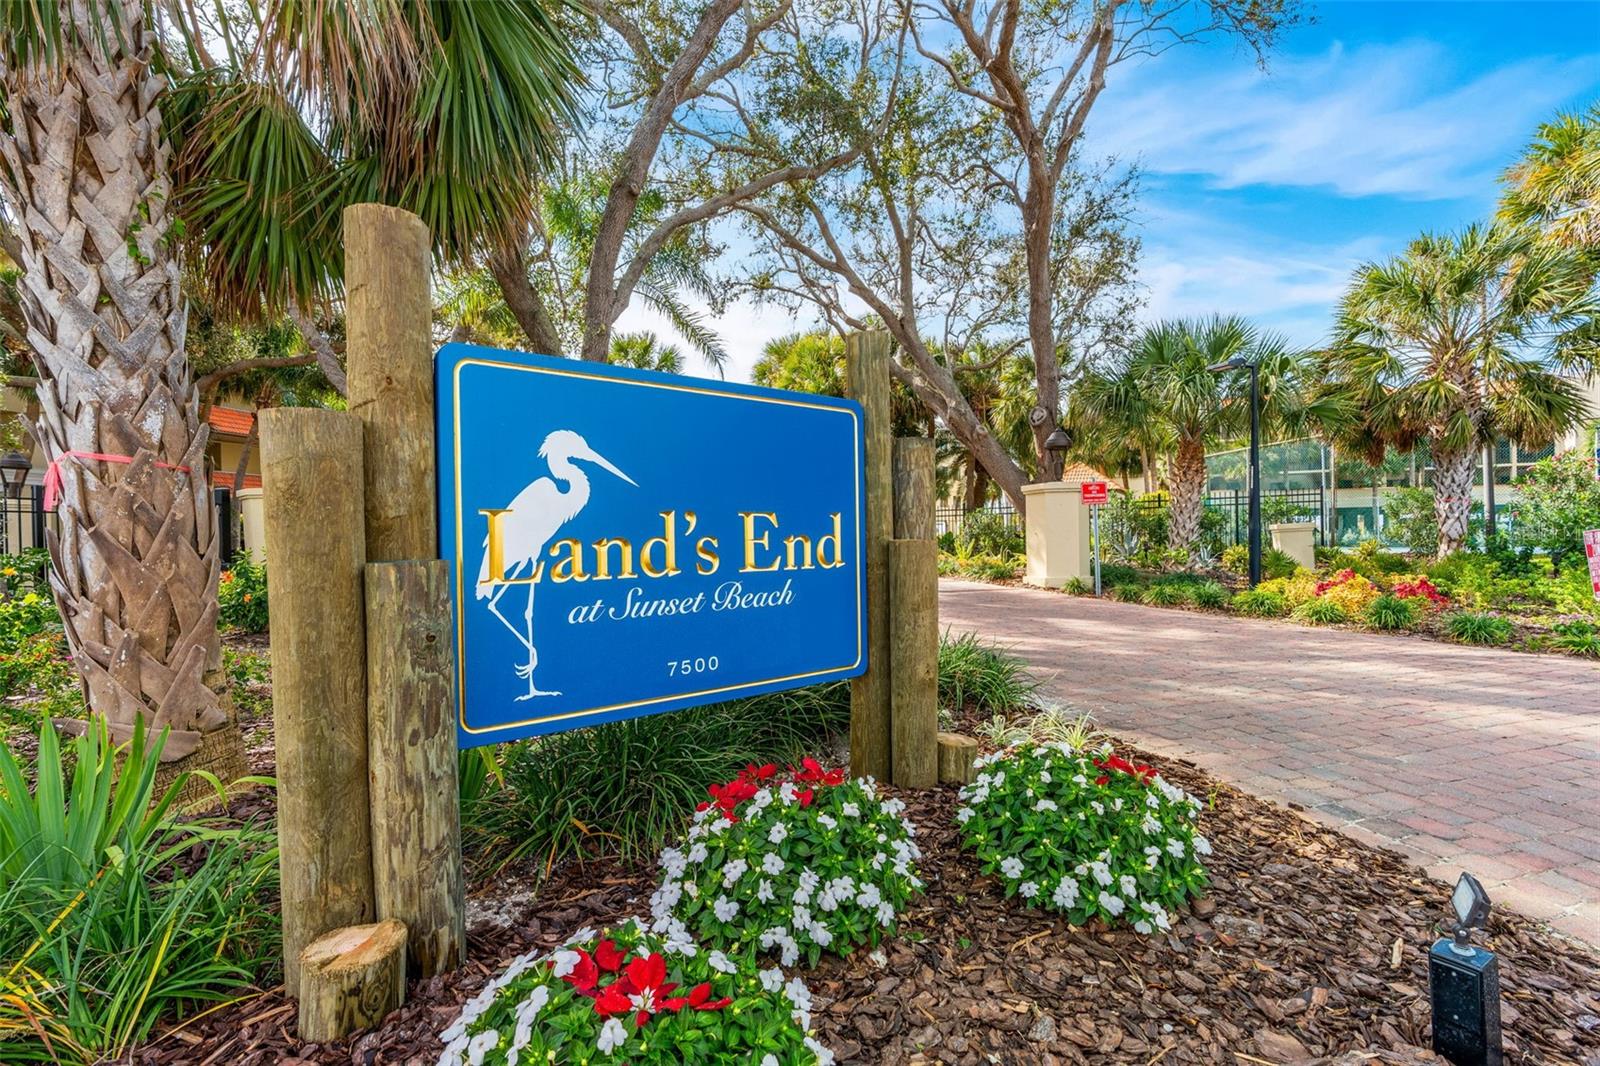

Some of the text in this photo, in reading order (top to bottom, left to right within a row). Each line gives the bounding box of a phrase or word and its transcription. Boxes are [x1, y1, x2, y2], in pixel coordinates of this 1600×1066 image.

[478, 509, 846, 585] Land's End
[568, 578, 796, 624] at Sunset Beach
[667, 656, 719, 677] 7500
